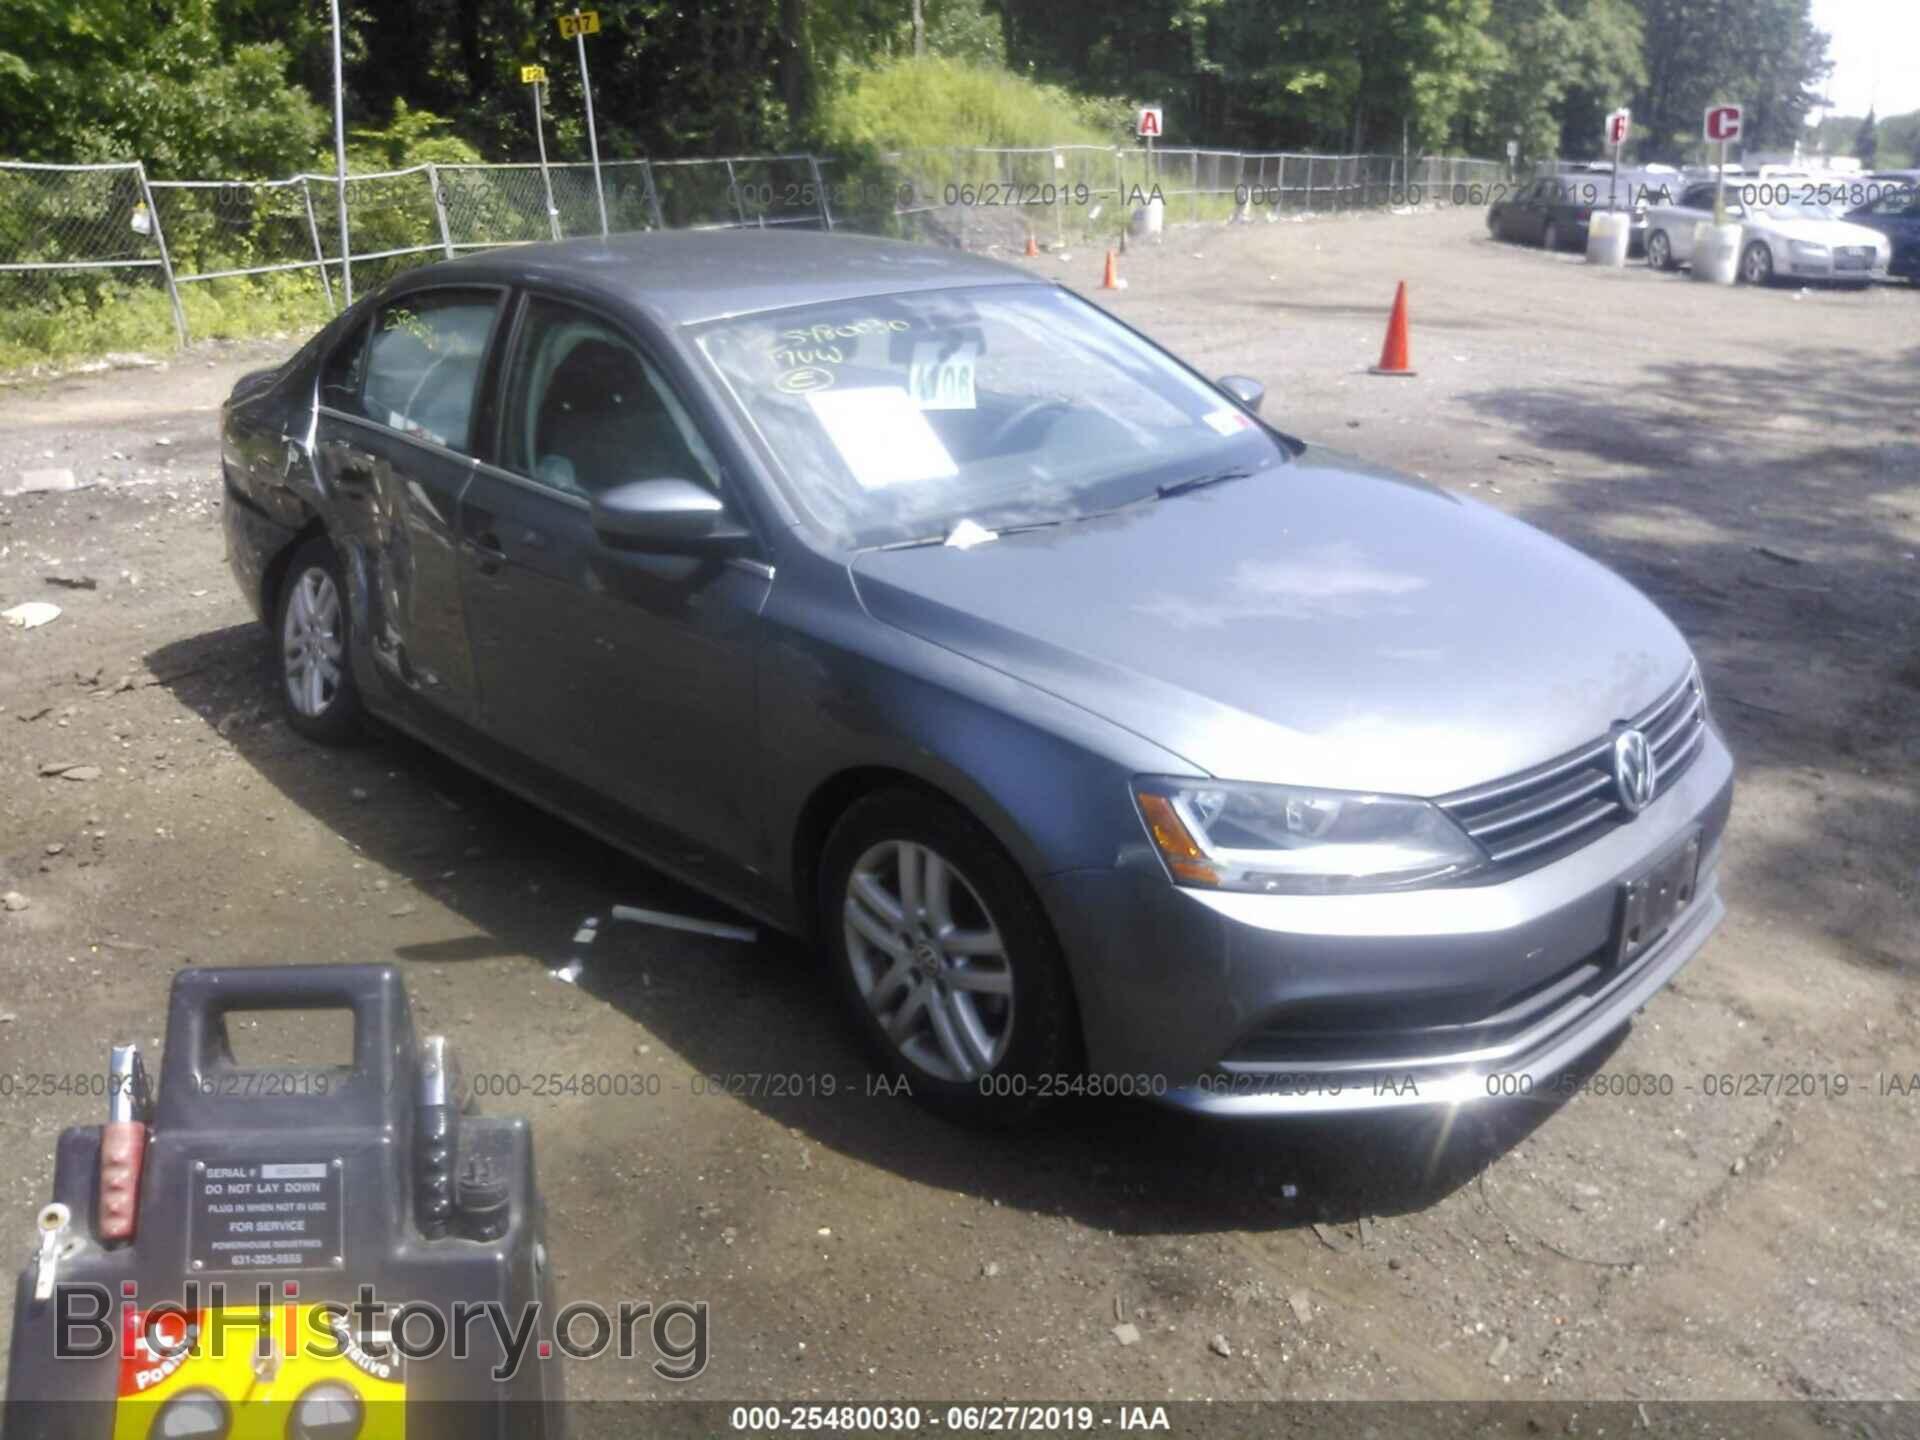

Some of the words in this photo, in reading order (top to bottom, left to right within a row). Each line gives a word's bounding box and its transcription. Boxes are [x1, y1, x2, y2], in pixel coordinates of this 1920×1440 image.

[564, 15, 591, 34] 217
[1141, 111, 1159, 133] A
[1708, 107, 1739, 140] C
[206, 1167, 247, 1178] SERIAL
[204, 1184, 223, 1195] DO
[227, 1183, 252, 1194] NOT
[256, 1182, 280, 1193] LAY
[284, 1182, 321, 1192] DOWN
[207, 1204, 234, 1213] PLUG
[234, 1203, 245, 1212] IN
[246, 1203, 274, 1212] WHEN
[275, 1202, 295, 1211] NOT
[308, 1202, 327, 1211] USE
[229, 1221, 253, 1232] FOR
[256, 1220, 305, 1231] SERVICE
